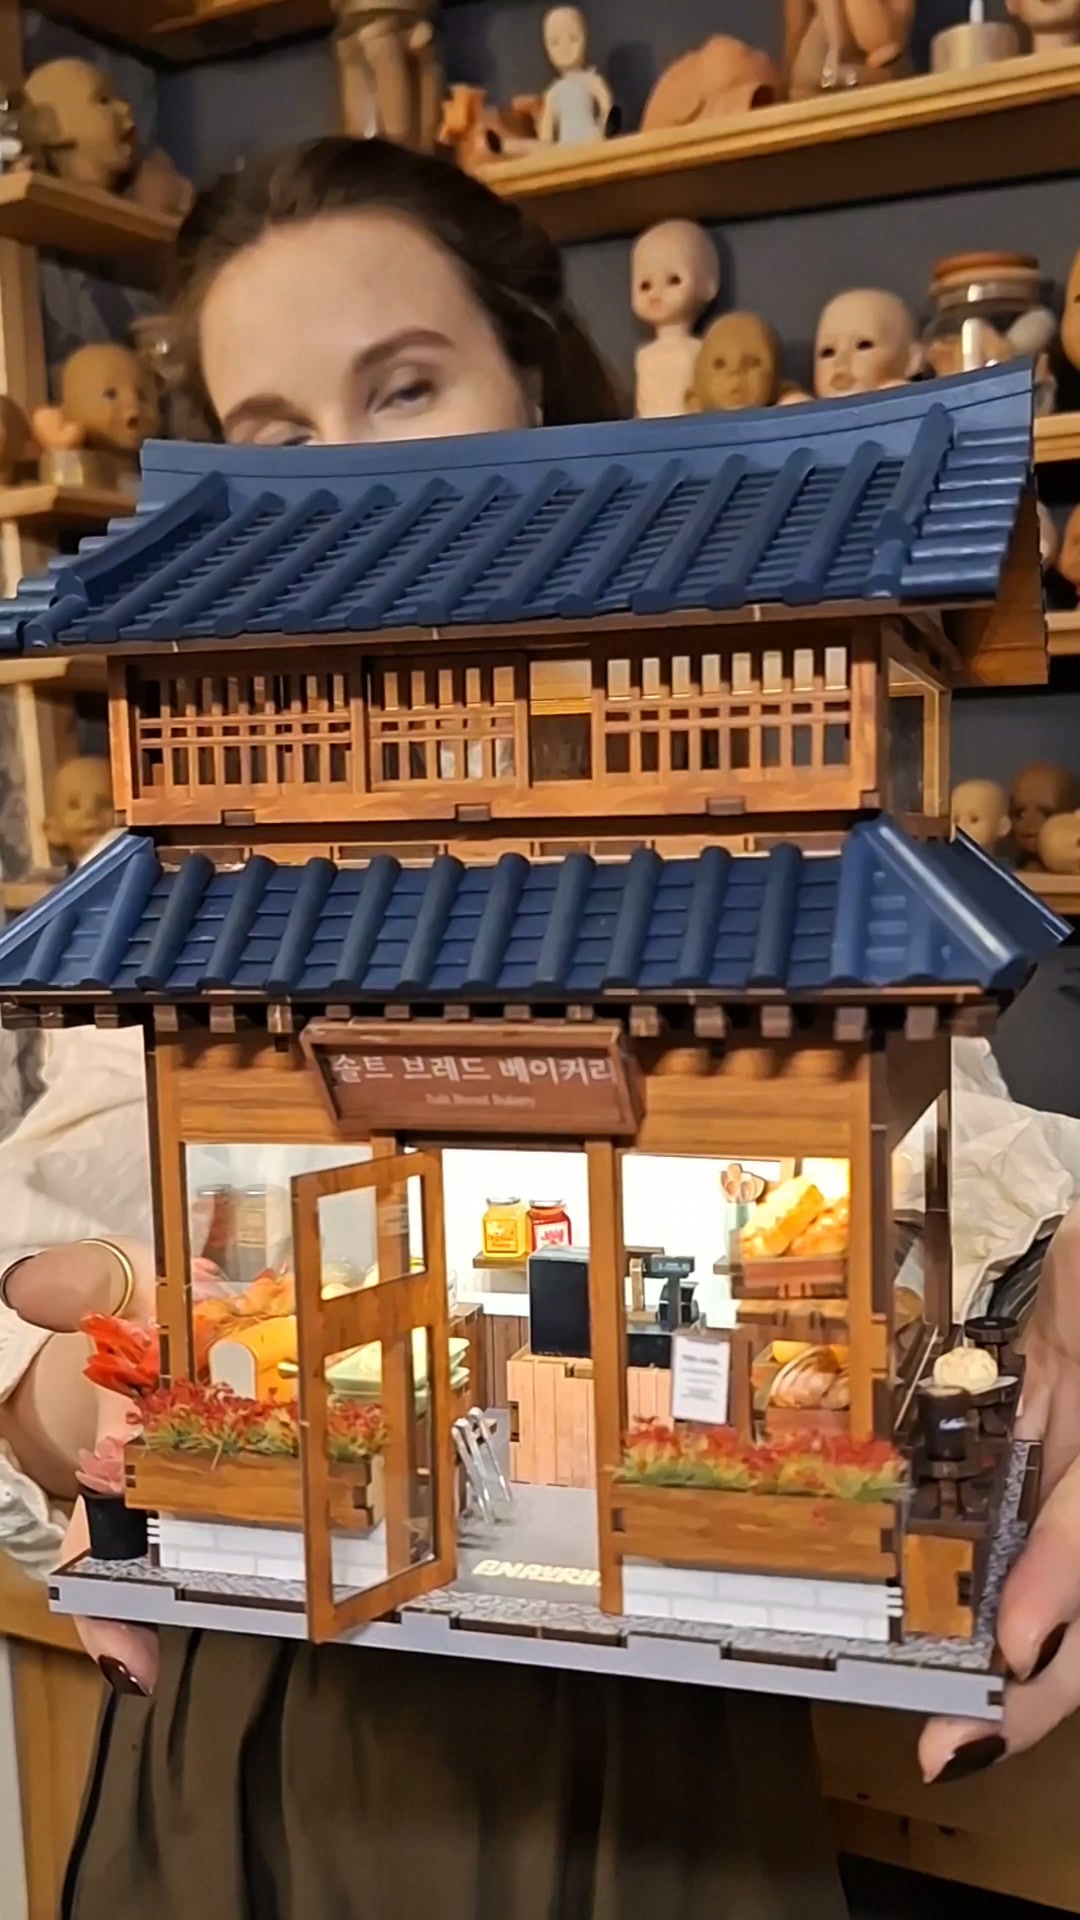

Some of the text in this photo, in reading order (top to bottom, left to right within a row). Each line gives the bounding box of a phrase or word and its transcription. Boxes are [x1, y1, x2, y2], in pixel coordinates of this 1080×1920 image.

[332, 1054, 619, 1085] 솔트 브레드 베이커리
